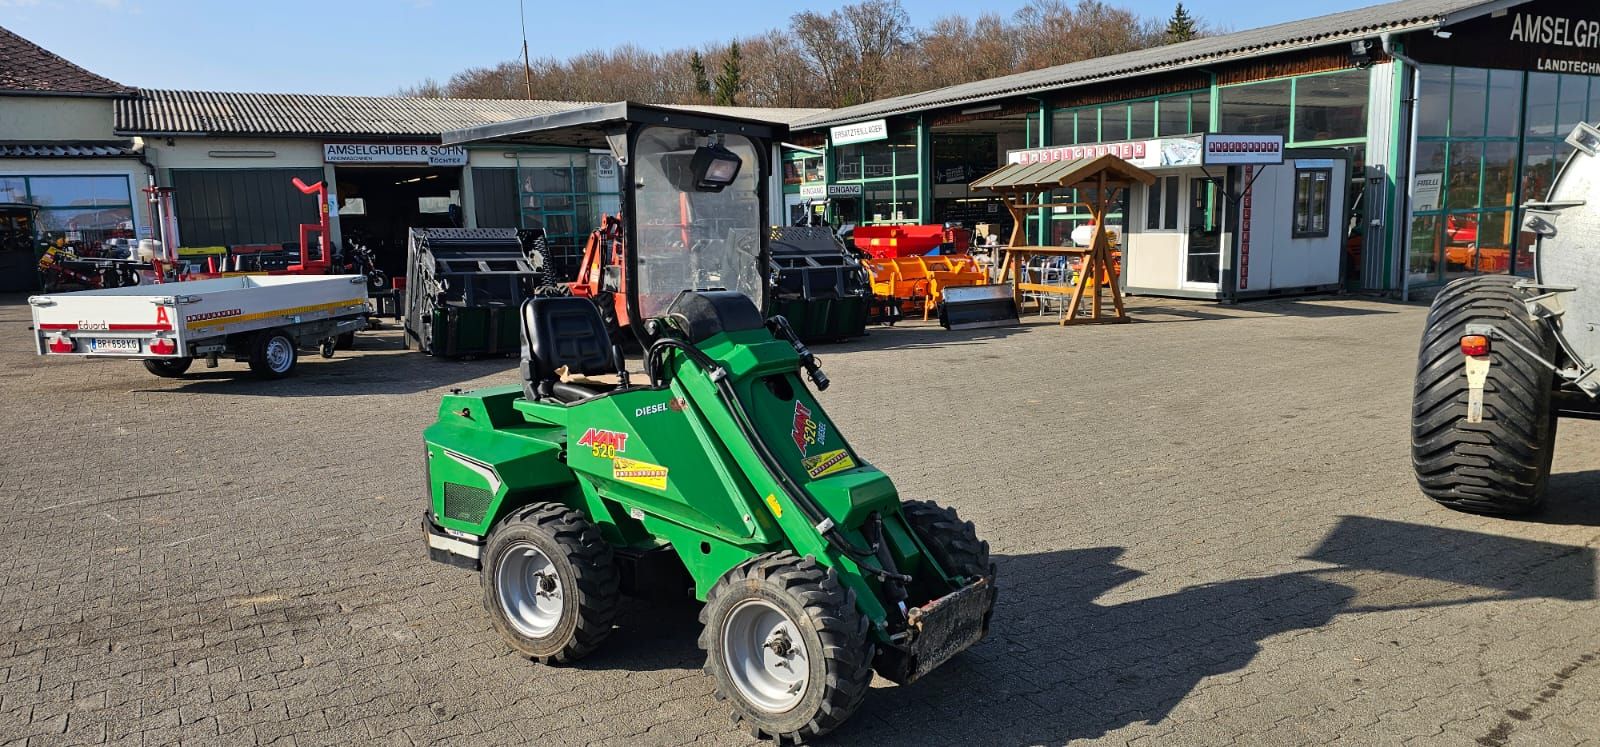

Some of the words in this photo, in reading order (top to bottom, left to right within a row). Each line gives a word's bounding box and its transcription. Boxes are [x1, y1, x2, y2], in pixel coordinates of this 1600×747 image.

[1510, 13, 1600, 48] AMSELGR
[328, 145, 418, 155] AMSELGRUBER
[420, 146, 428, 155] &
[430, 145, 463, 155] SOHN
[1020, 142, 1145, 165] AMSELGRUBER
[79, 320, 107, 330] Eduard
[156, 306, 169, 324] A
[635, 402, 668, 417] DIESEL
[791, 400, 811, 458] AVANT
[804, 418, 817, 445] 520
[576, 428, 628, 452] AVANT
[592, 442, 615, 458] 520
